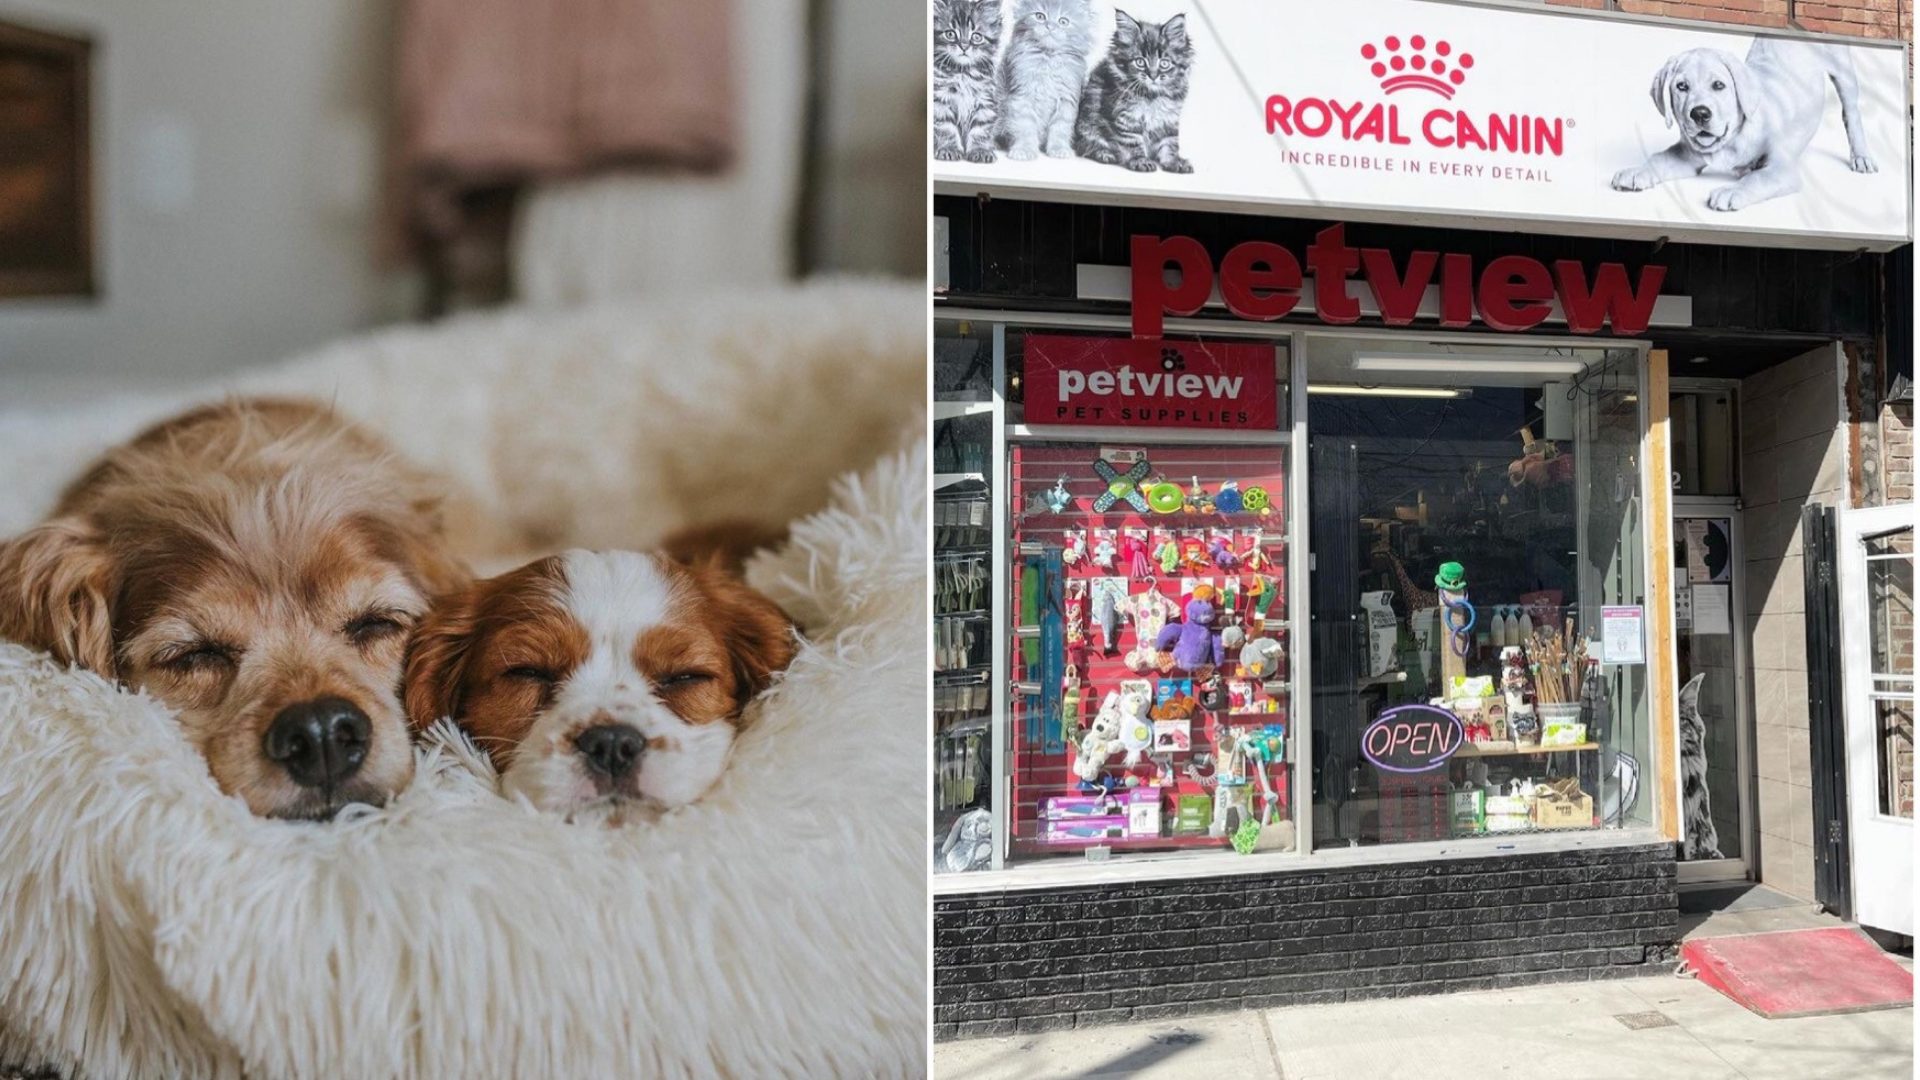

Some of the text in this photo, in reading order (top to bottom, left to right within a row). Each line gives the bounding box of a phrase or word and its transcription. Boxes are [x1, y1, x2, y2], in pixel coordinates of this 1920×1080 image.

[1265, 94, 1411, 145] ROYAL
[1281, 150, 1552, 182] INCREDIBLE IN EVERY DETAIL
[1130, 223, 1668, 341] petview
[1058, 361, 1244, 402] petview
[1056, 406, 1249, 424] PET SUPPLIES
[1368, 722, 1453, 757] OPEN
